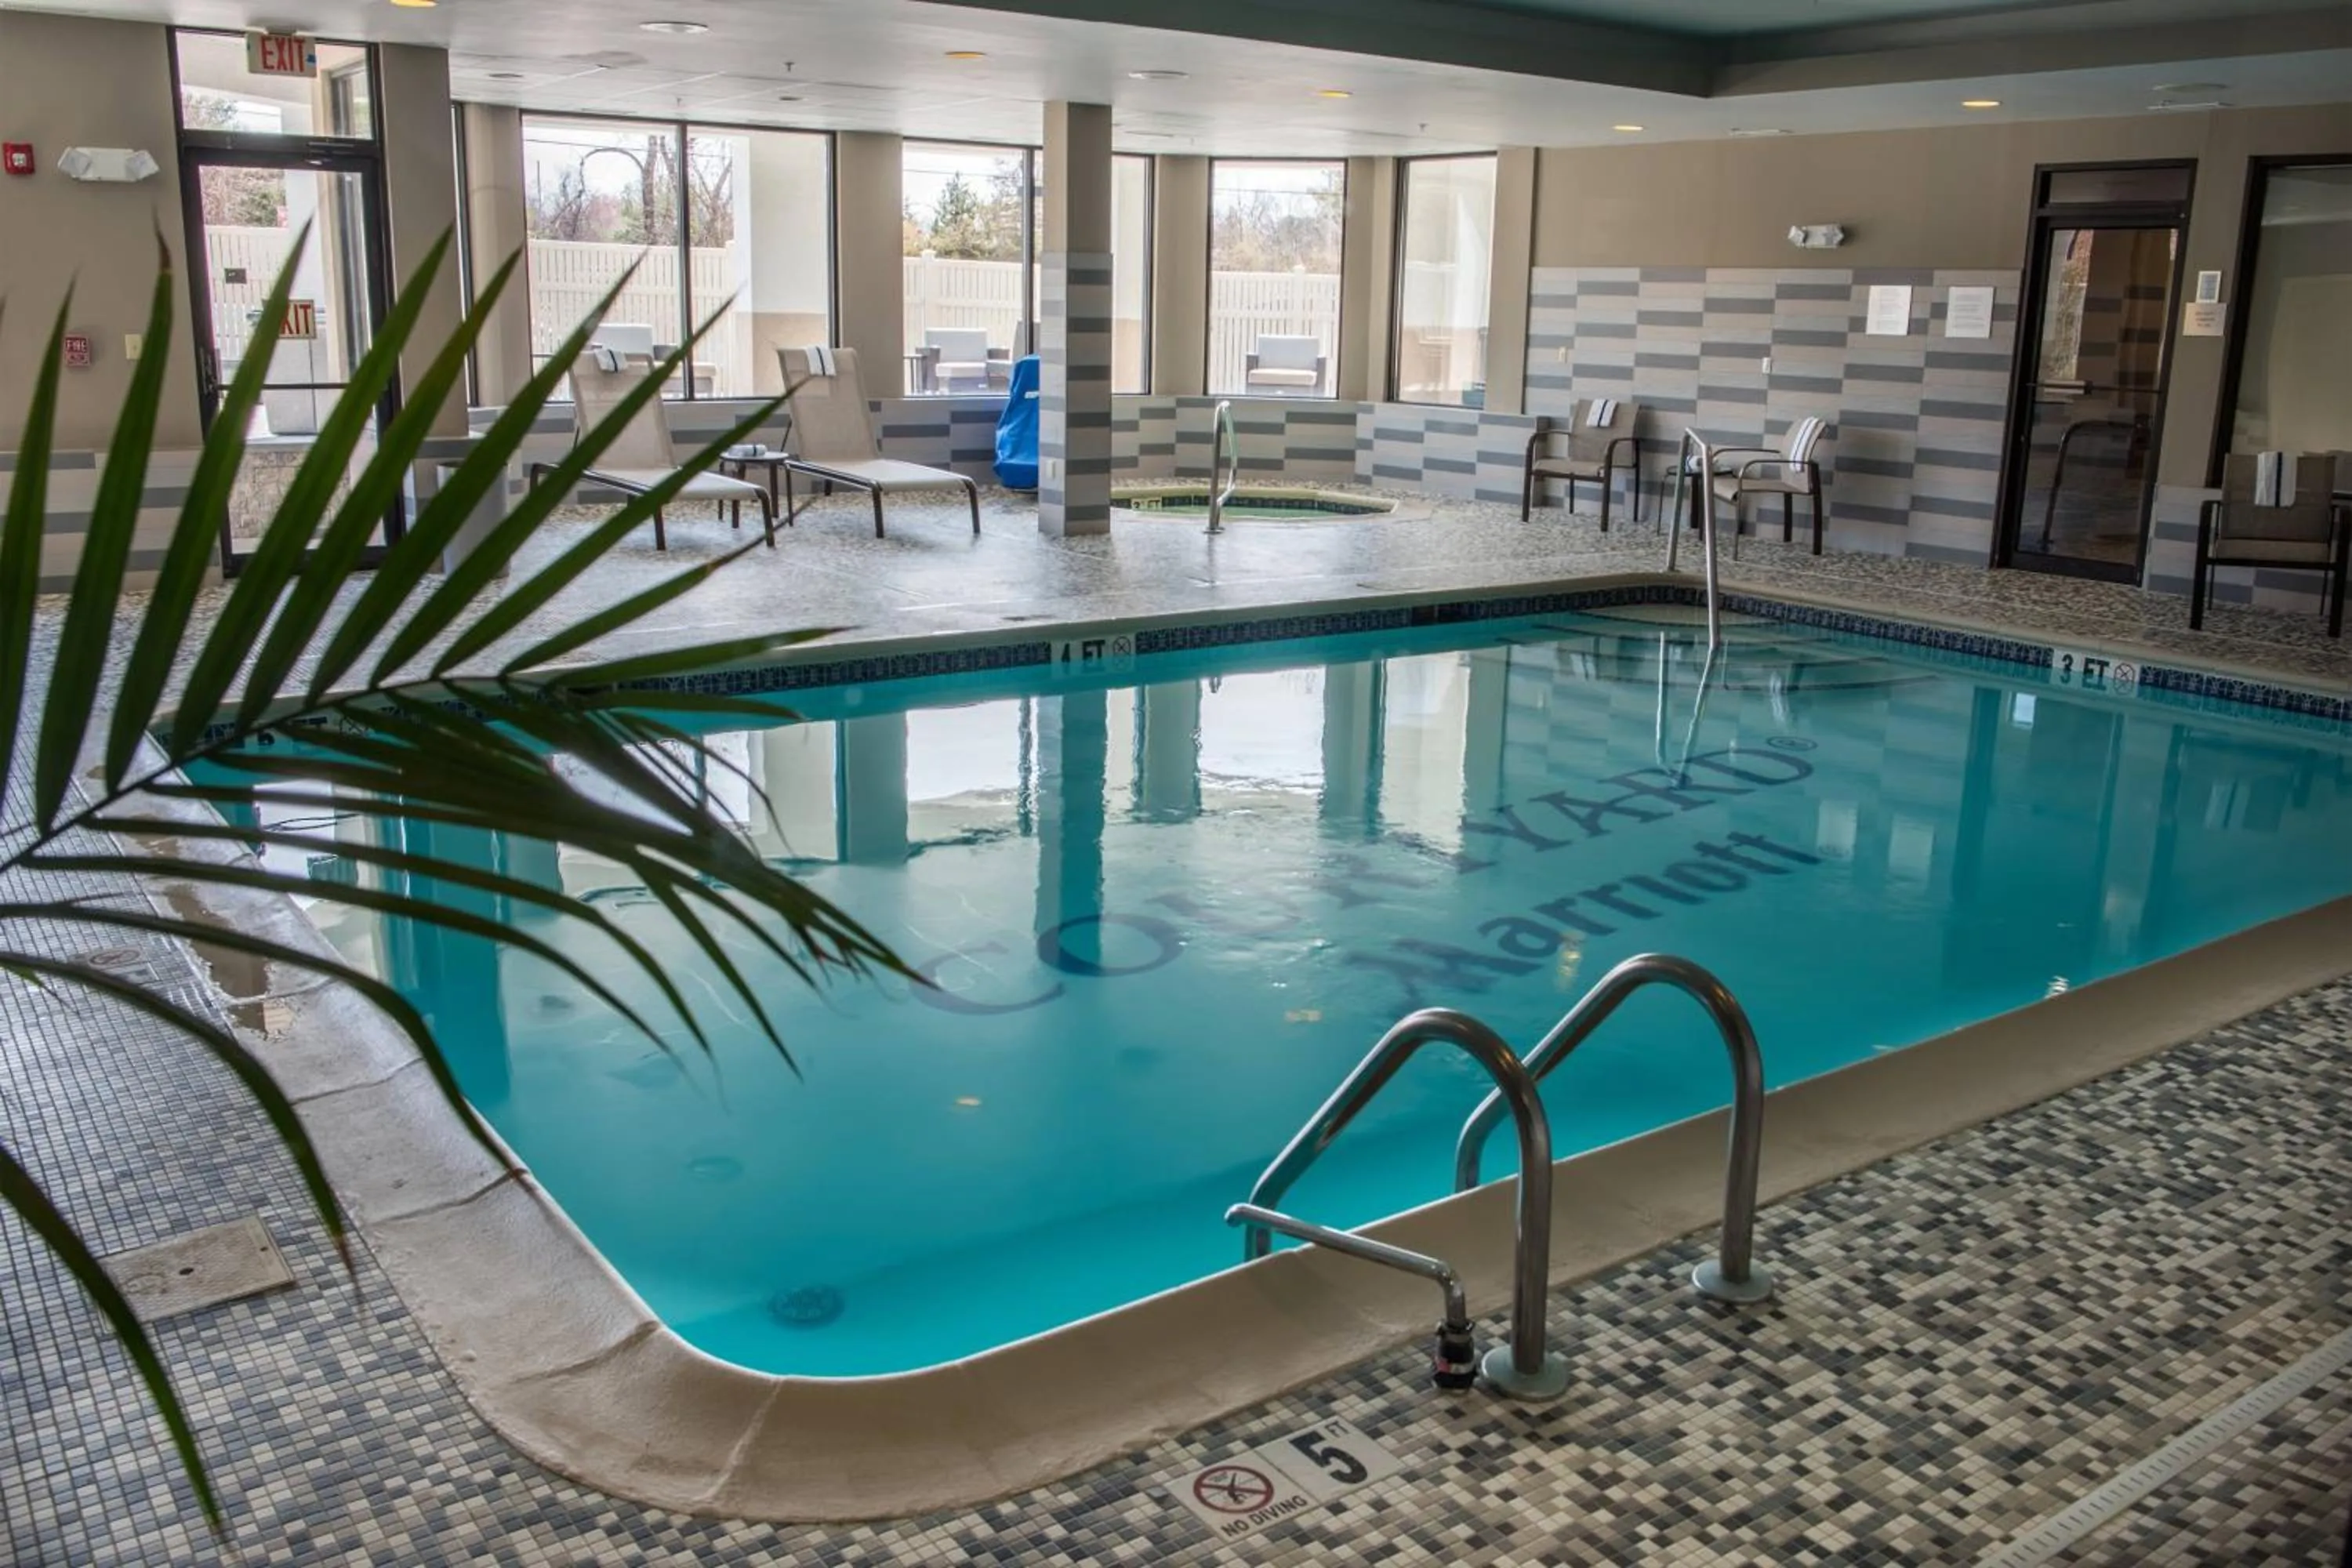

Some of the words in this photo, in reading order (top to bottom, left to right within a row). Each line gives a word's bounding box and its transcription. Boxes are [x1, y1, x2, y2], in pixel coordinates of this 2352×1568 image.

[261, 34, 306, 73] EXIT
[279, 303, 311, 335] XIT
[1082, 639, 1105, 660] FT
[2083, 657, 2111, 677] FT
[1324, 1421, 1349, 1438] FT
[1289, 1430, 1368, 1484] 5
[1221, 1519, 1250, 1537] NO
[1248, 1495, 1308, 1526] DIVING
